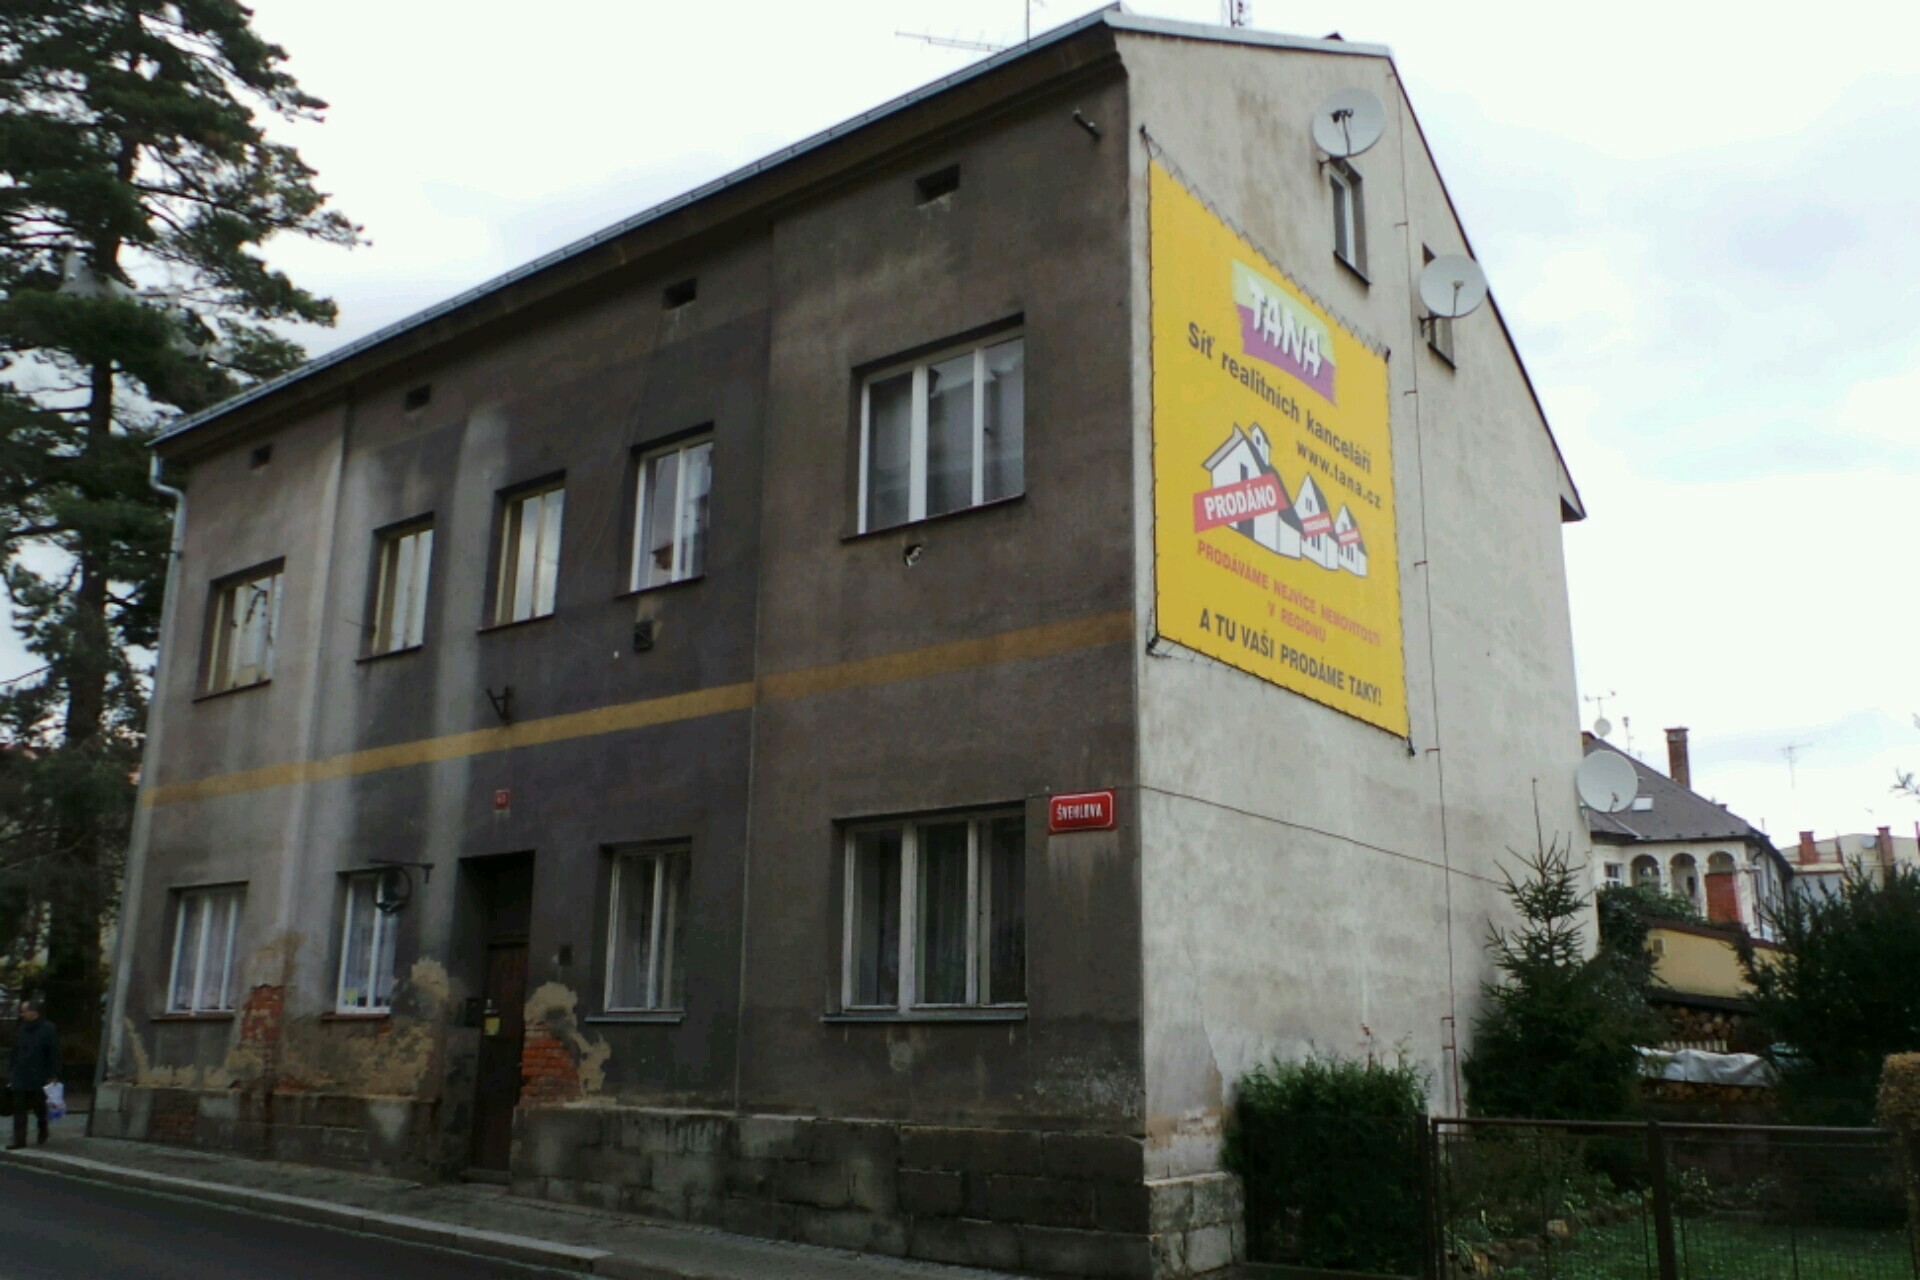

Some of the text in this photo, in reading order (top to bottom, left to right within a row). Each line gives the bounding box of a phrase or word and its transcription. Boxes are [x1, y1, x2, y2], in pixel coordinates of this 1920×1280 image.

[1247, 276, 1322, 377] TANA
[1204, 484, 1277, 521] PRODÁNO
[1267, 600, 1276, 617] V
[1199, 607, 1382, 706] A TU VAŠI PRODÁME TAKY!
